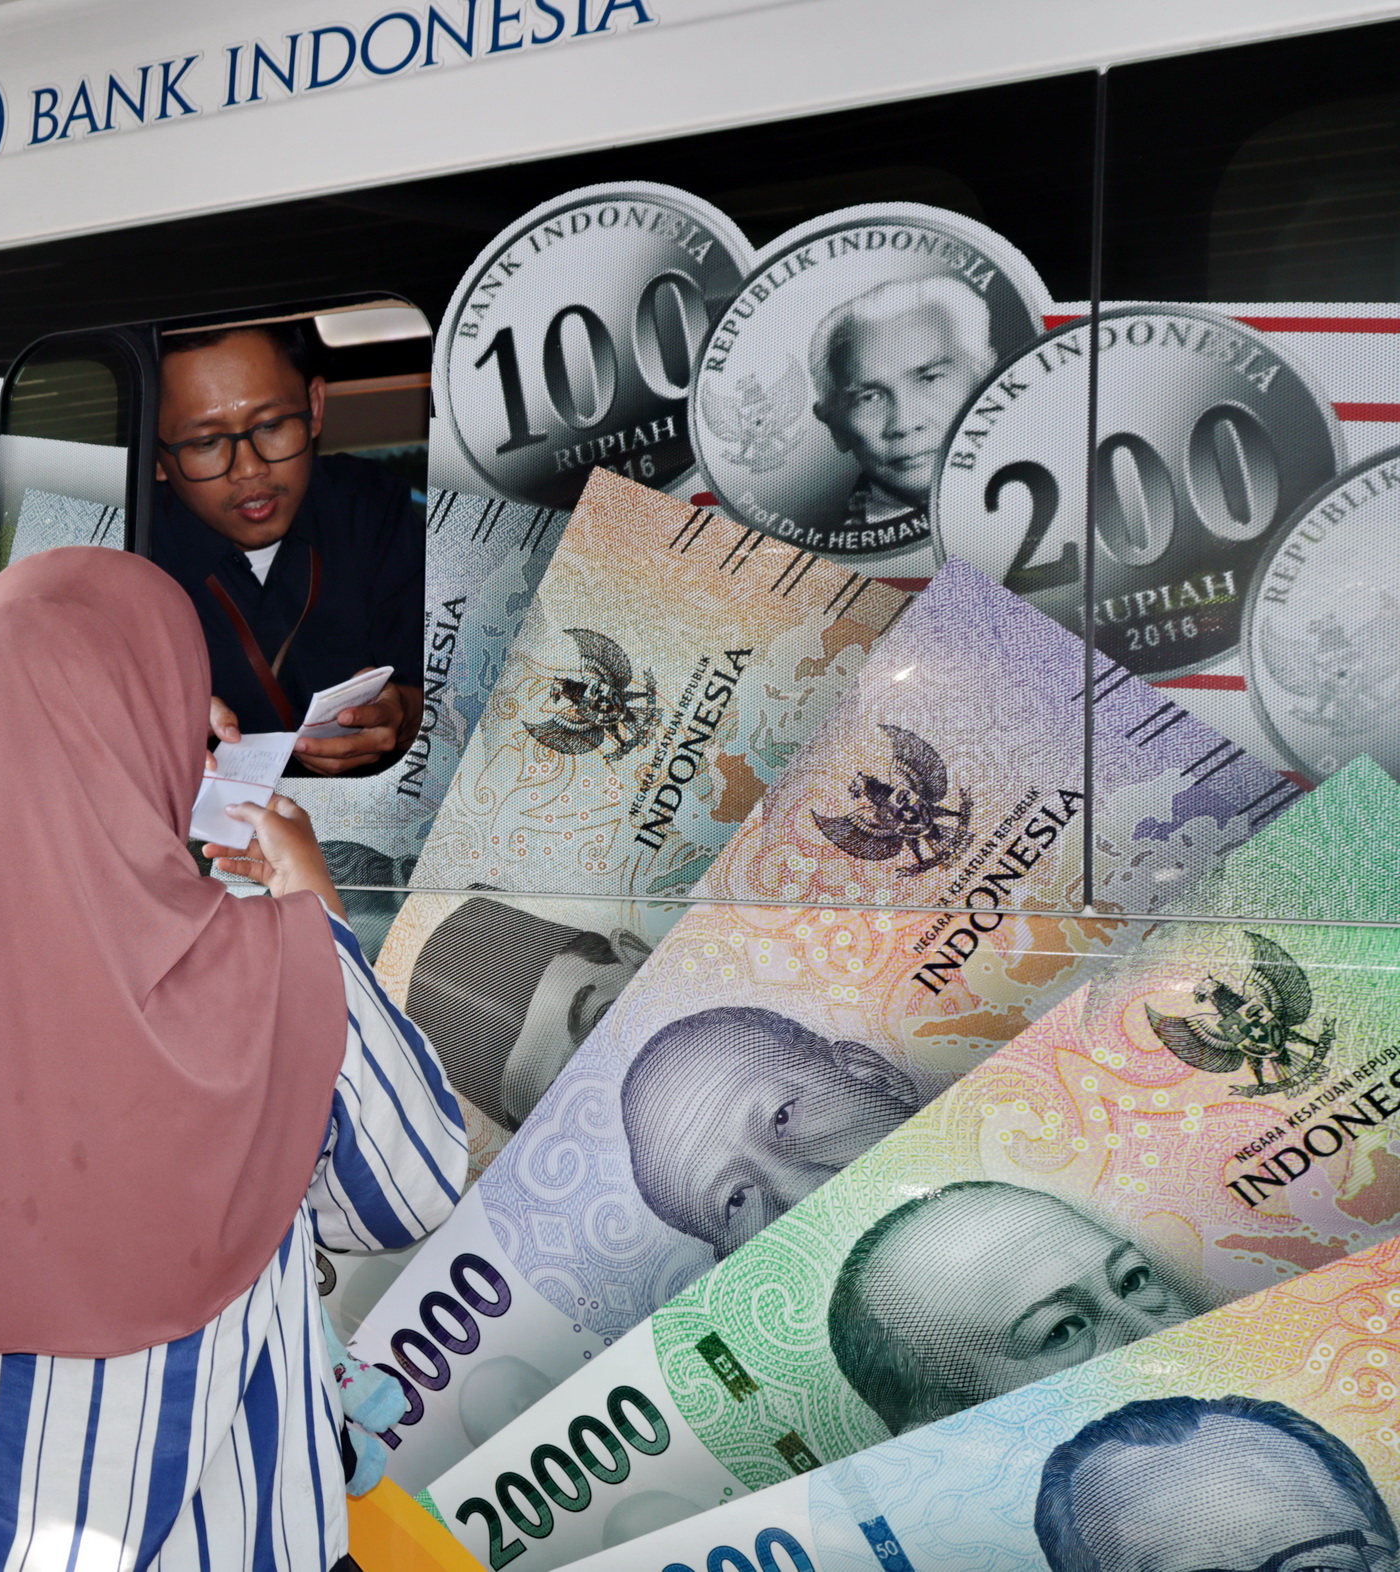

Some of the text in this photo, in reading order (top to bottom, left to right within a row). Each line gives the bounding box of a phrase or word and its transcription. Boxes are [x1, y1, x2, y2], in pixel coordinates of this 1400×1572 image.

[27, 0, 655, 146] BANK INDONESIA
[459, 205, 715, 339] BANK INDONESIA
[705, 229, 997, 374] REPUBLIK INDONESIA
[473, 269, 711, 456] 100
[950, 321, 1282, 471] BANK INDONESIA
[553, 415, 678, 473] RUPIAH
[983, 400, 1280, 596] 200
[1076, 569, 1237, 628] RUPIAH
[1125, 615, 1199, 651] 2016
[397, 594, 468, 800] INDONESIA
[628, 655, 711, 818] NEGARA KESATUAN REPUBLIK
[633, 648, 754, 851] INDONESIA
[910, 788, 1086, 997] INDONESIA
[912, 785, 1042, 956] NEGARA KESATUAN REPUBLIK
[1234, 1125, 1287, 1164] NEGARA
[1285, 1078, 1355, 1129] KESATUAN
[455, 1384, 671, 1572] 20000
[875, 1539, 899, 1560] 50
